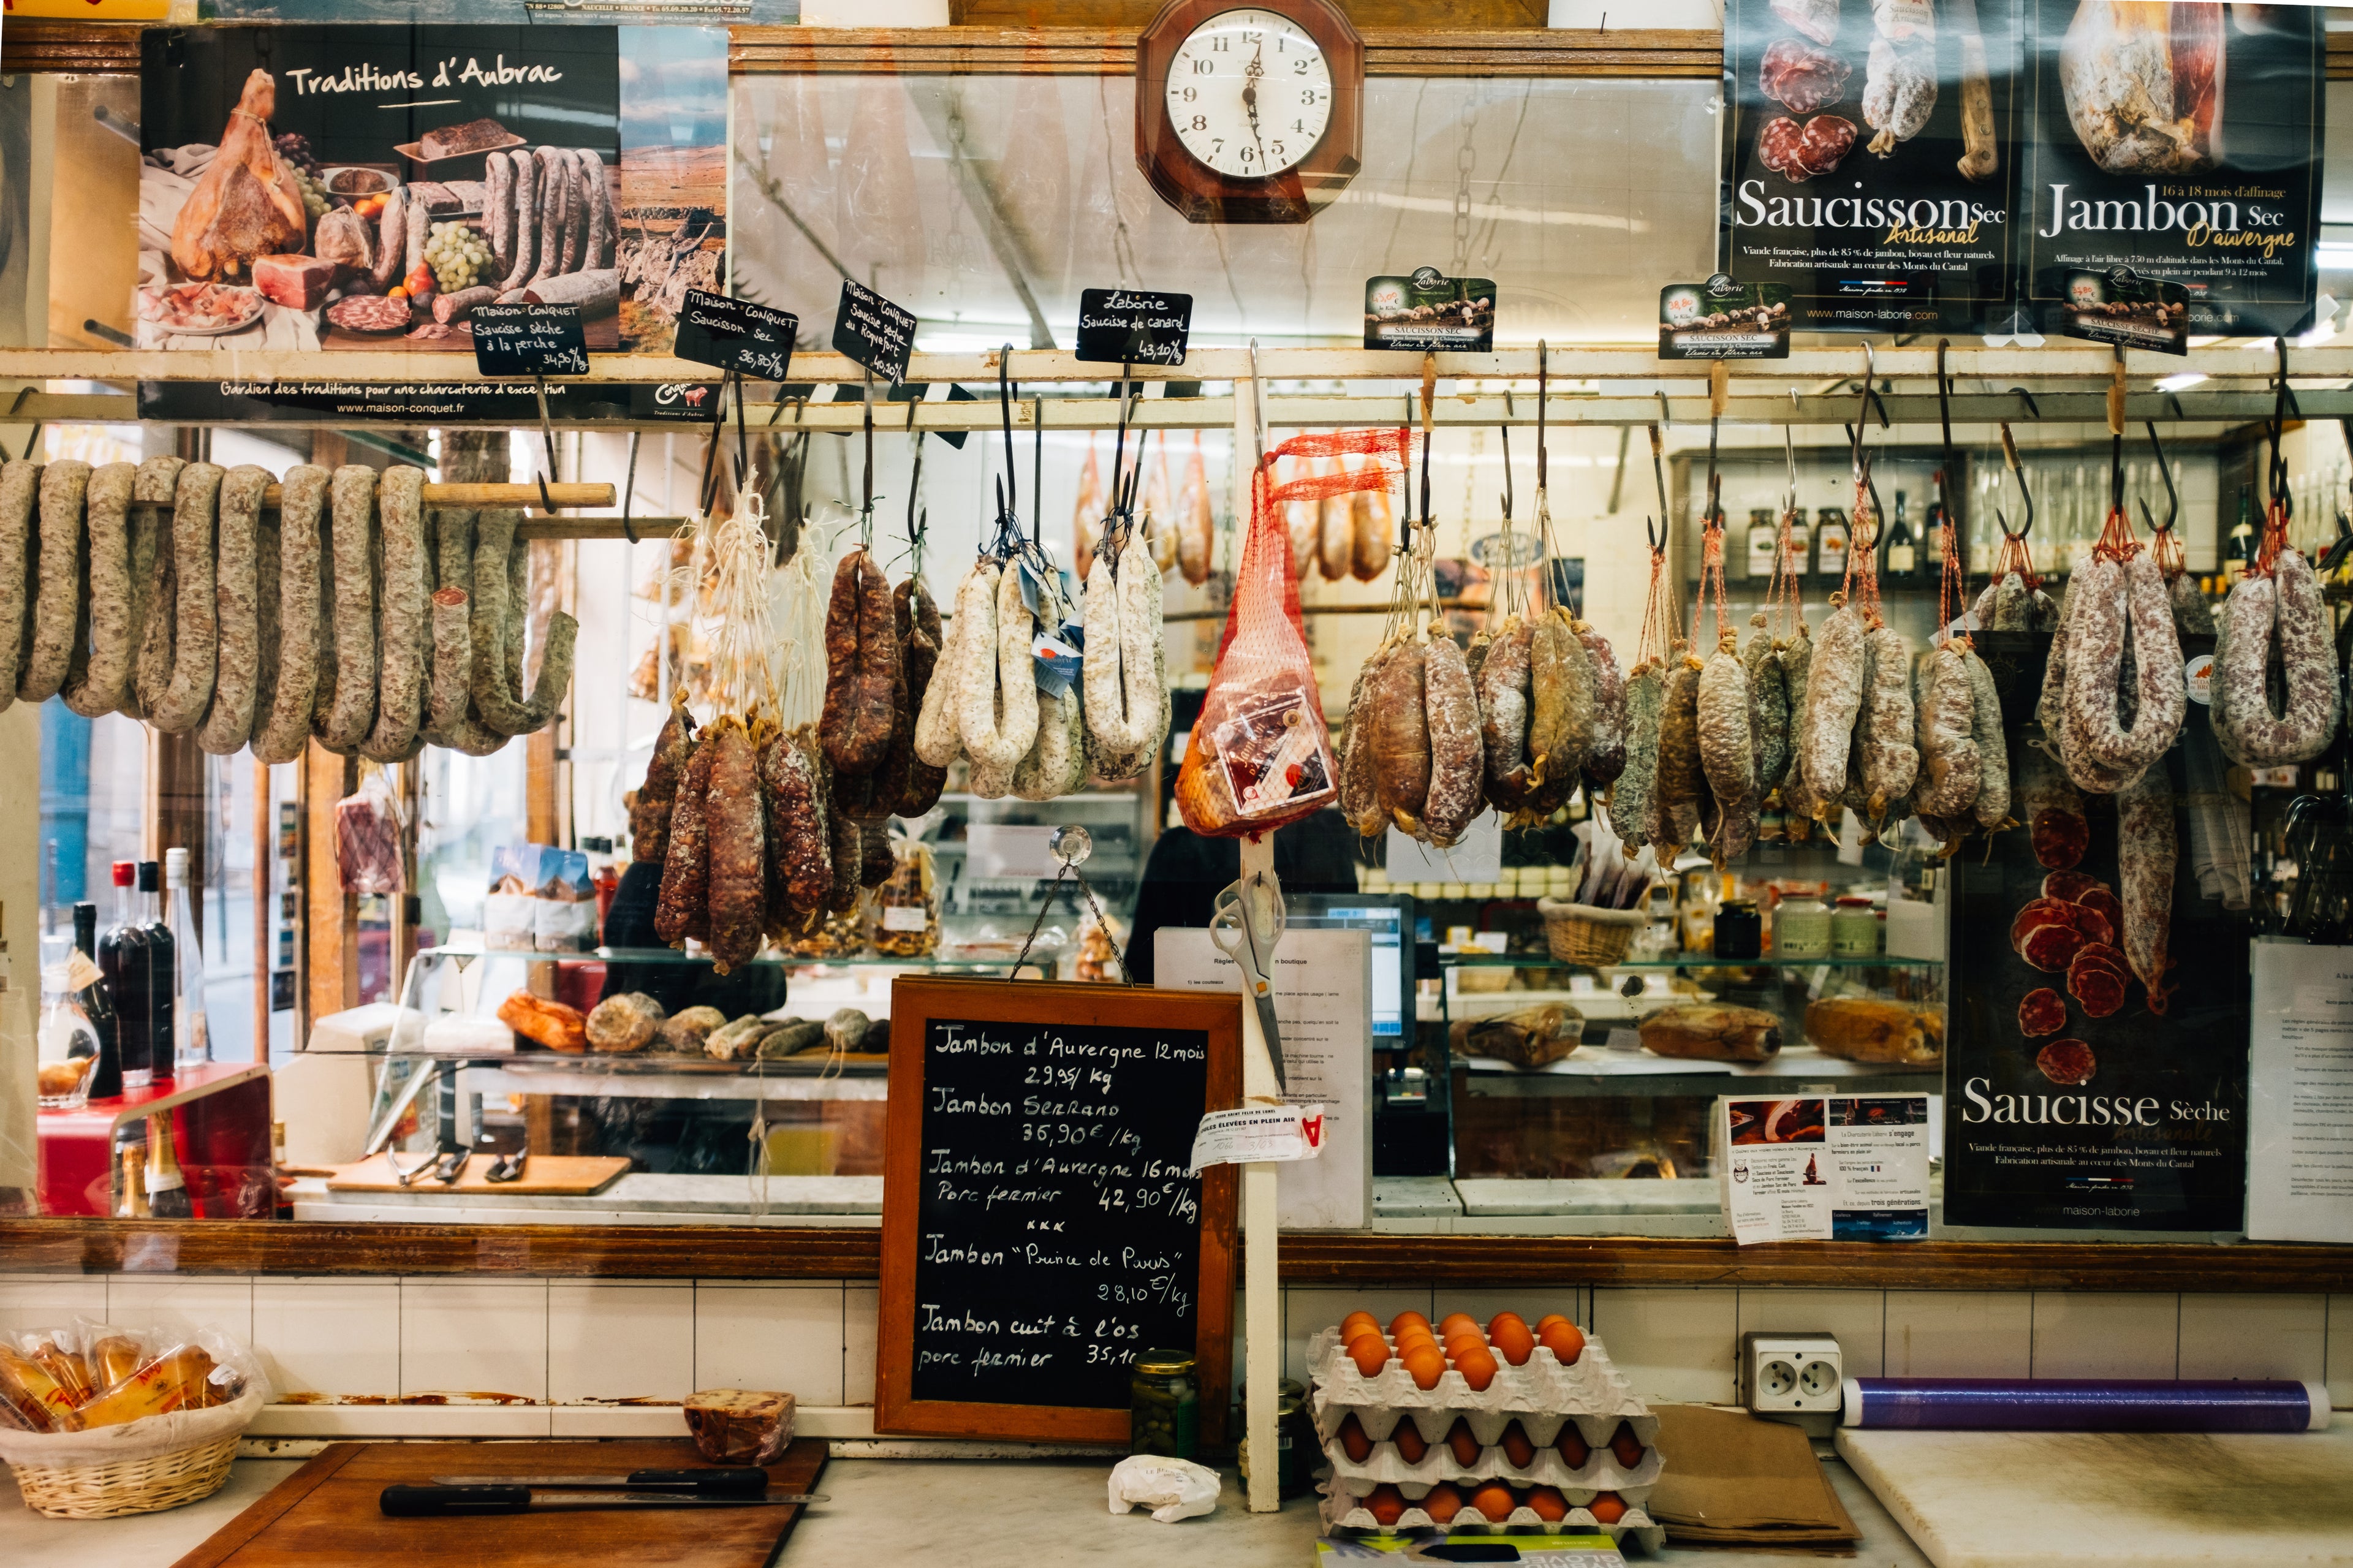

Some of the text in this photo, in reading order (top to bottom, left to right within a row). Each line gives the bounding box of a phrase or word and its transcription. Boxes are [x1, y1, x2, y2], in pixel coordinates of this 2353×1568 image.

[1213, 37, 1229, 52] 11
[1241, 31, 1263, 45] 12
[1278, 38, 1285, 53] 1
[286, 54, 563, 96] Traditions d'Aubrac
[1191, 59, 1214, 75] 10
[1294, 59, 1308, 75] 2
[1183, 87, 1197, 102] 9
[1301, 89, 1316, 106] 3
[1191, 115, 1207, 131] 8
[1290, 119, 1304, 133] 4
[1211, 138, 1225, 153] 7
[1271, 140, 1286, 155] 5
[1240, 146, 1255, 163] 6
[2162, 186, 2286, 199] 16 à 18 mois d'affinage
[1736, 179, 2006, 230] Saucisson Sec
[2039, 184, 2284, 238] Jambon Sec
[1884, 218, 1979, 246] Artisanal
[1743, 246, 1771, 256] Viande
[1773, 246, 1809, 257] française,
[1811, 248, 1828, 257] plus
[1829, 248, 1840, 256] de
[1863, 248, 1873, 257] de
[1873, 249, 1907, 259] jambon,
[1909, 249, 1933, 259] boyau
[1944, 249, 1963, 259] fleur
[1964, 250, 1995, 259] naturels
[2053, 254, 2084, 264] Affinage
[2131, 255, 2145, 263] 750
[2156, 256, 2189, 264] d'altitude
[2190, 256, 2208, 265] dans
[2221, 256, 2245, 265] Monts
[2246, 256, 2256, 265] du
[2258, 257, 2284, 266] Cantal,
[1769, 259, 1813, 268] Fabrication
[1814, 260, 1851, 268] artisanale
[1887, 261, 1901, 270] des
[1903, 262, 1928, 270] Monts
[1942, 262, 1968, 271] Cantal
[2162, 268, 2181, 276] plein
[2182, 267, 2192, 276] air
[2194, 268, 2224, 277] pendant
[1412, 270, 1449, 290] Laborie
[1707, 276, 1745, 298] Laborie
[689, 290, 798, 328] Maison CONQUET
[844, 279, 915, 331] Maison CONQUET
[1104, 291, 1169, 311] Laborie
[471, 305, 580, 317] Maison CONQUET
[851, 303, 881, 329] Saucisse
[1806, 308, 1938, 320] www.maison-laborie.com
[475, 320, 565, 336] Saucisse sèche
[690, 311, 746, 333] Saucisson
[1081, 314, 1188, 331] Saucisse de canard
[2091, 319, 2161, 336] SAUCISSE SÈCHE
[487, 336, 558, 356] à la perche
[861, 323, 900, 357] Roquefort
[220, 381, 492, 398] Gardien des traditions pour une charcuterie
[336, 403, 464, 414] www.maison-conquet.fr
[934, 1025, 1014, 1056] Jambon
[1023, 1031, 1146, 1069] d'Auvergne
[932, 1086, 1012, 1116] Jambon
[1962, 1077, 2230, 1126] Saucisse Sèche
[1218, 1119, 1247, 1129] ÉLEVÉES
[1889, 1129, 1915, 1138] s'engage
[928, 1148, 1161, 1188] Jambon d'Auvergne 16
[938, 1181, 978, 1202] Porc
[987, 1185, 1063, 1211] fermier
[925, 1233, 1004, 1265] Jambon
[1089, 1248, 1111, 1267] de
[921, 1303, 1140, 1339] Jambon cuit à l'os
[919, 1347, 1053, 1377] porc fermier
[1514, 1555, 1620, 1564] GLOVES
